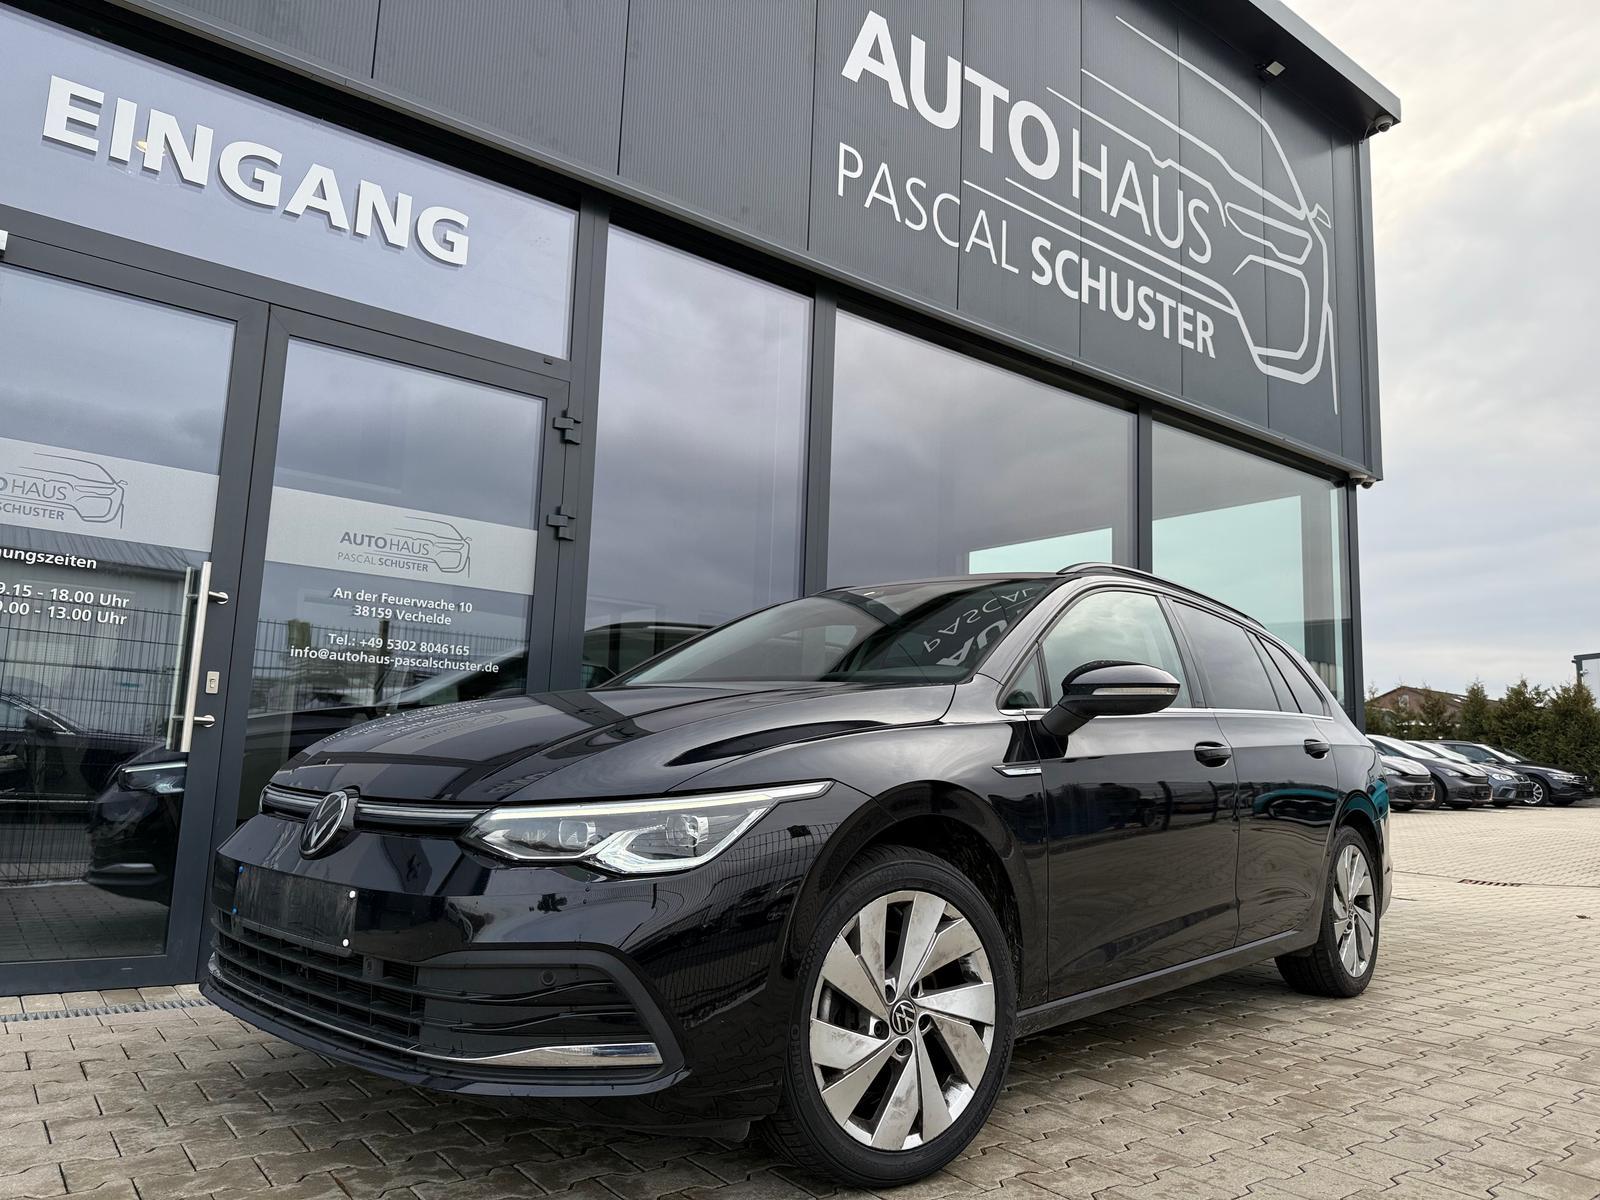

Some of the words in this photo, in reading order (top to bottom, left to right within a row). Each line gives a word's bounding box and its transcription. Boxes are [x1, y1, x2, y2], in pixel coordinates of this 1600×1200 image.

[42, 74, 470, 266] EINGANG
[837, 141, 1020, 275] PASCAL
[1030, 235, 1217, 360] SCHUSTER
[0, 547, 97, 570] ungszeiten
[337, 551, 376, 566] PASCAL
[377, 556, 429, 573] SCHUSTER
[50, 587, 94, 604] 18.00
[99, 592, 130, 608] Uhr
[333, 587, 352, 600] An
[355, 590, 378, 602] der
[381, 593, 455, 611] Feuerwache
[459, 601, 473, 613] 10
[0, 601, 30, 616] .00
[47, 606, 92, 623] 13.00
[97, 610, 128, 625] Uhr
[354, 604, 393, 619] 38159
[396, 609, 452, 625] Vechelde
[328, 633, 356, 647] Tel.:
[359, 636, 384, 650] +49
[387, 638, 416, 652] 5302
[419, 641, 470, 656] 8046165
[290, 645, 500, 674] info@autohaus-pascalschuster.de
